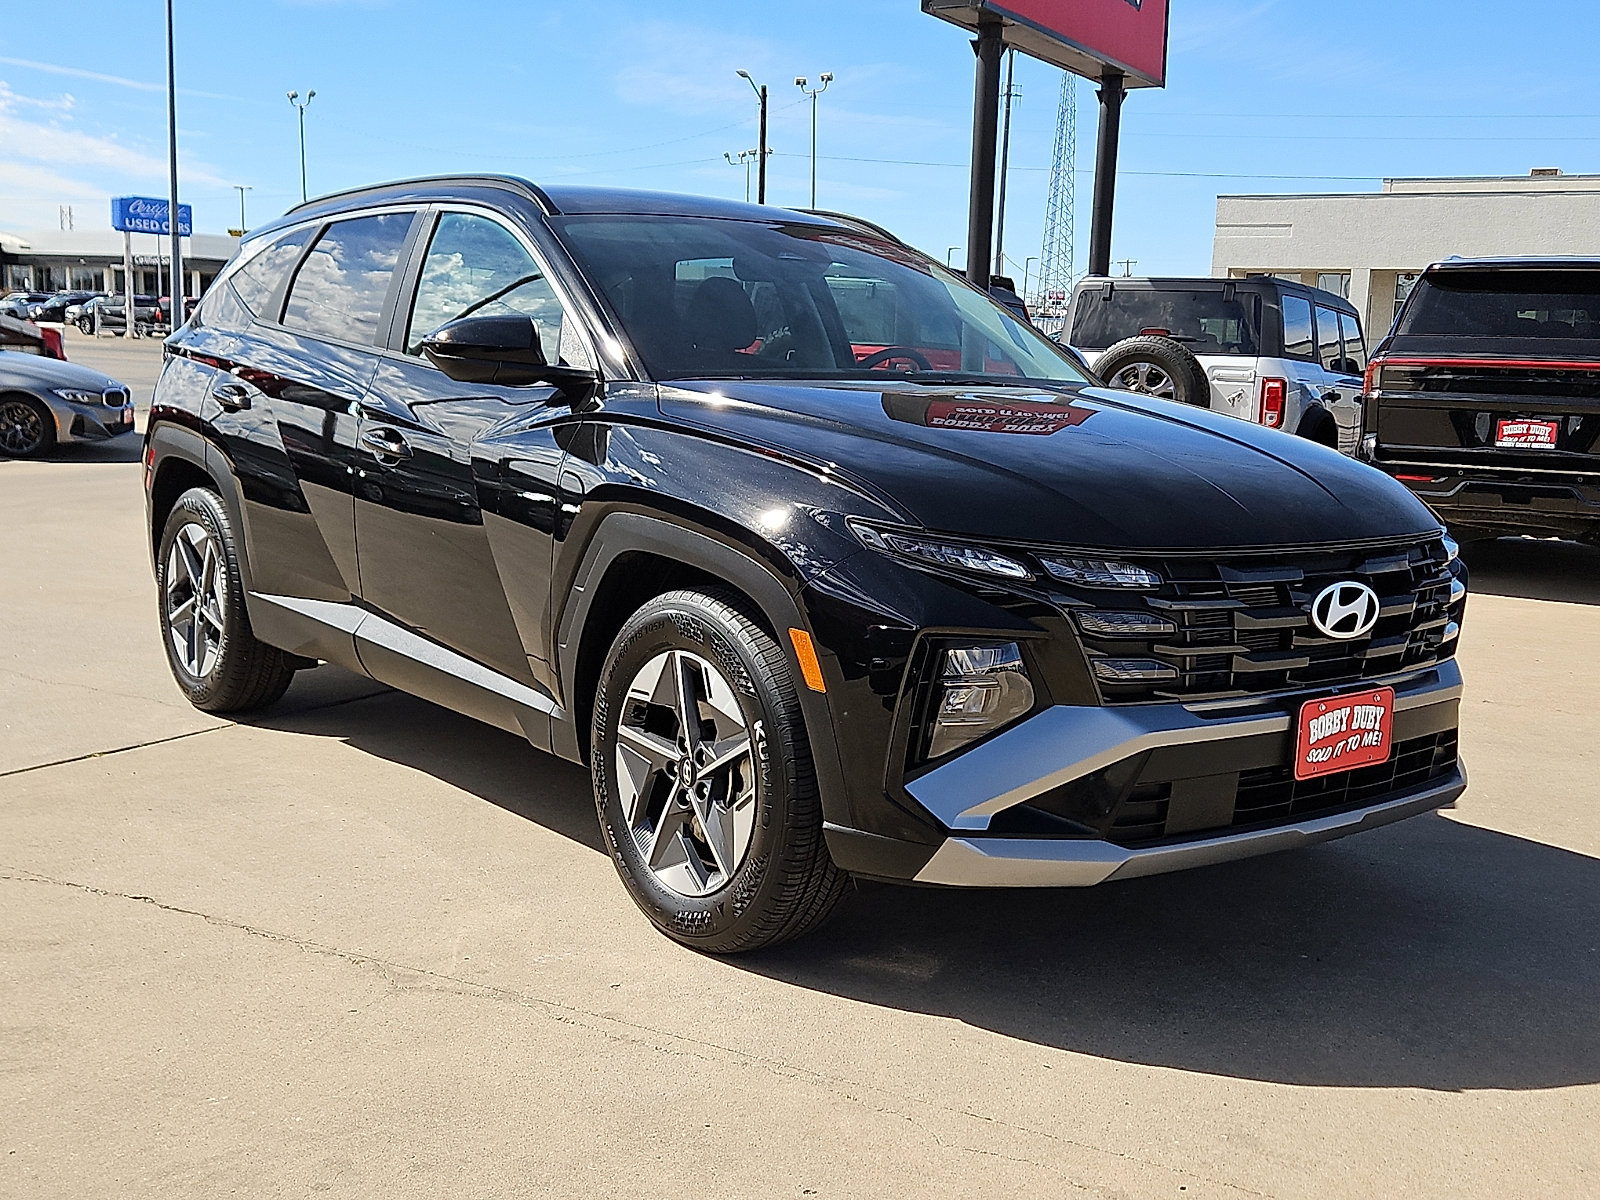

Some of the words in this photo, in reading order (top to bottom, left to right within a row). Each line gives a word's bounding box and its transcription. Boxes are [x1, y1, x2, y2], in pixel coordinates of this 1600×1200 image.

[124, 217, 160, 231] USED
[161, 221, 190, 233] CRS
[1308, 706, 1351, 746] BOBBY
[1351, 704, 1386, 731] DUBY
[1305, 746, 1333, 764] SOLD
[1332, 740, 1347, 759] IT
[1346, 734, 1361, 753] TO
[1360, 731, 1383, 747] ME!
